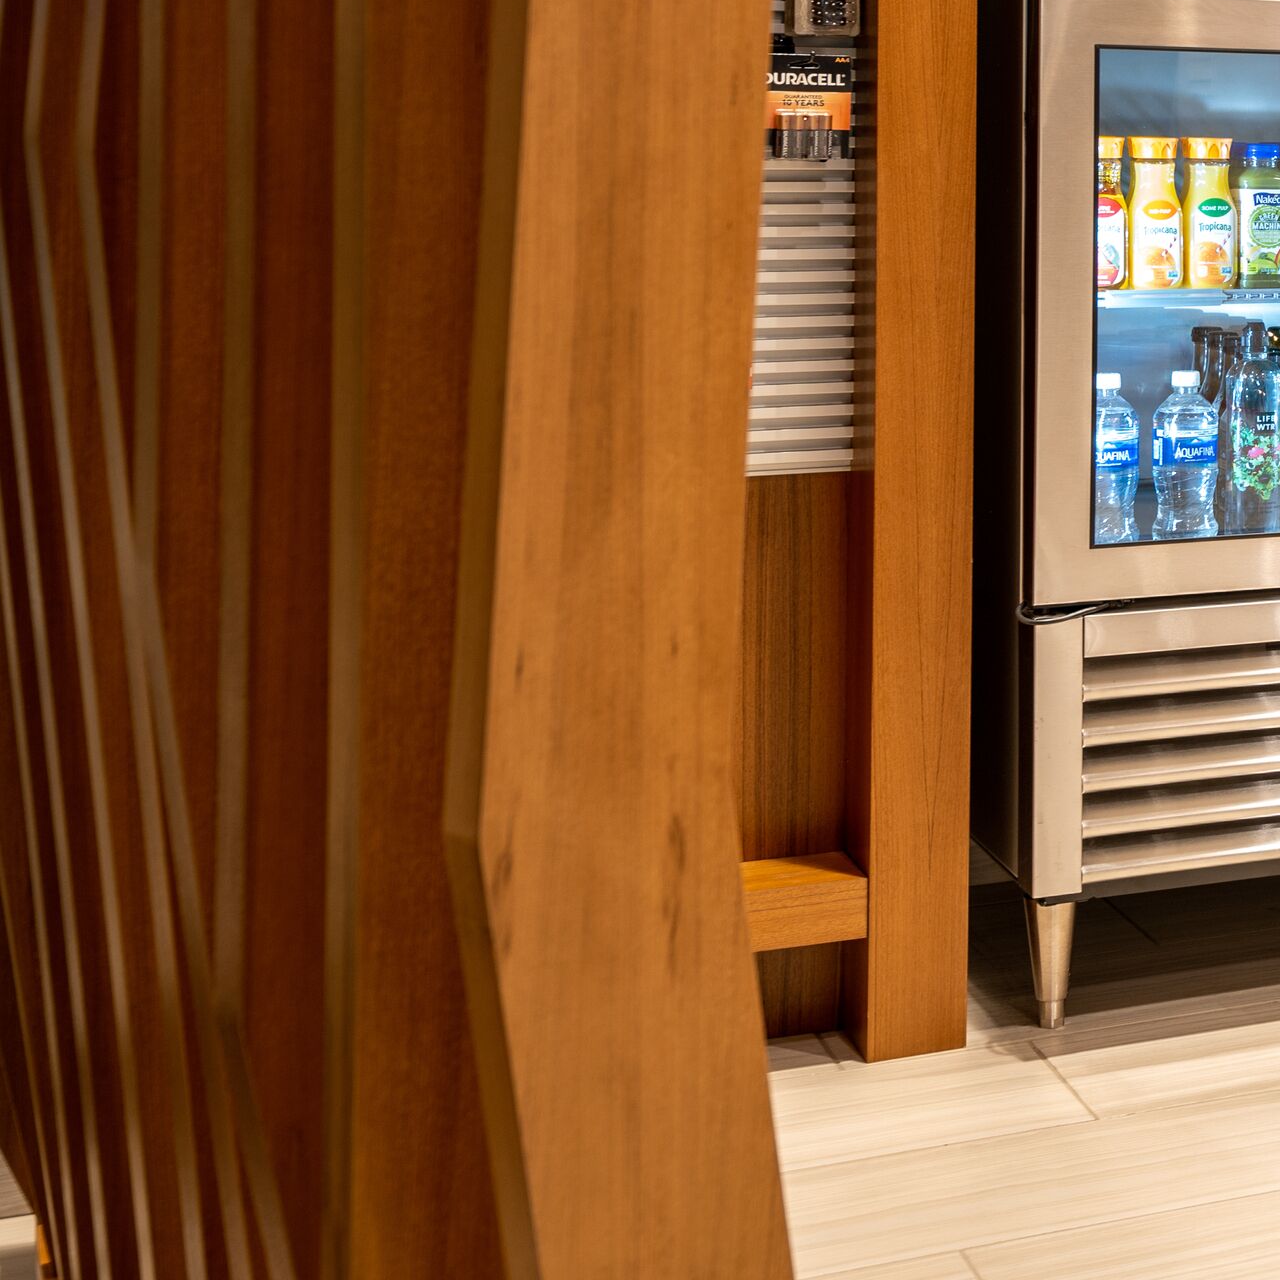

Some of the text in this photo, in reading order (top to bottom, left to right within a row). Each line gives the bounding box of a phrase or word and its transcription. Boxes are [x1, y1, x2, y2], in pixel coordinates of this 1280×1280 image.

[765, 72, 845, 86] DURACELL
[782, 99, 825, 108] 10 YEARS
[1199, 222, 1232, 232] Tropicana
[1257, 415, 1276, 423] LIFE
[1175, 446, 1215, 458] AQUAFINA
